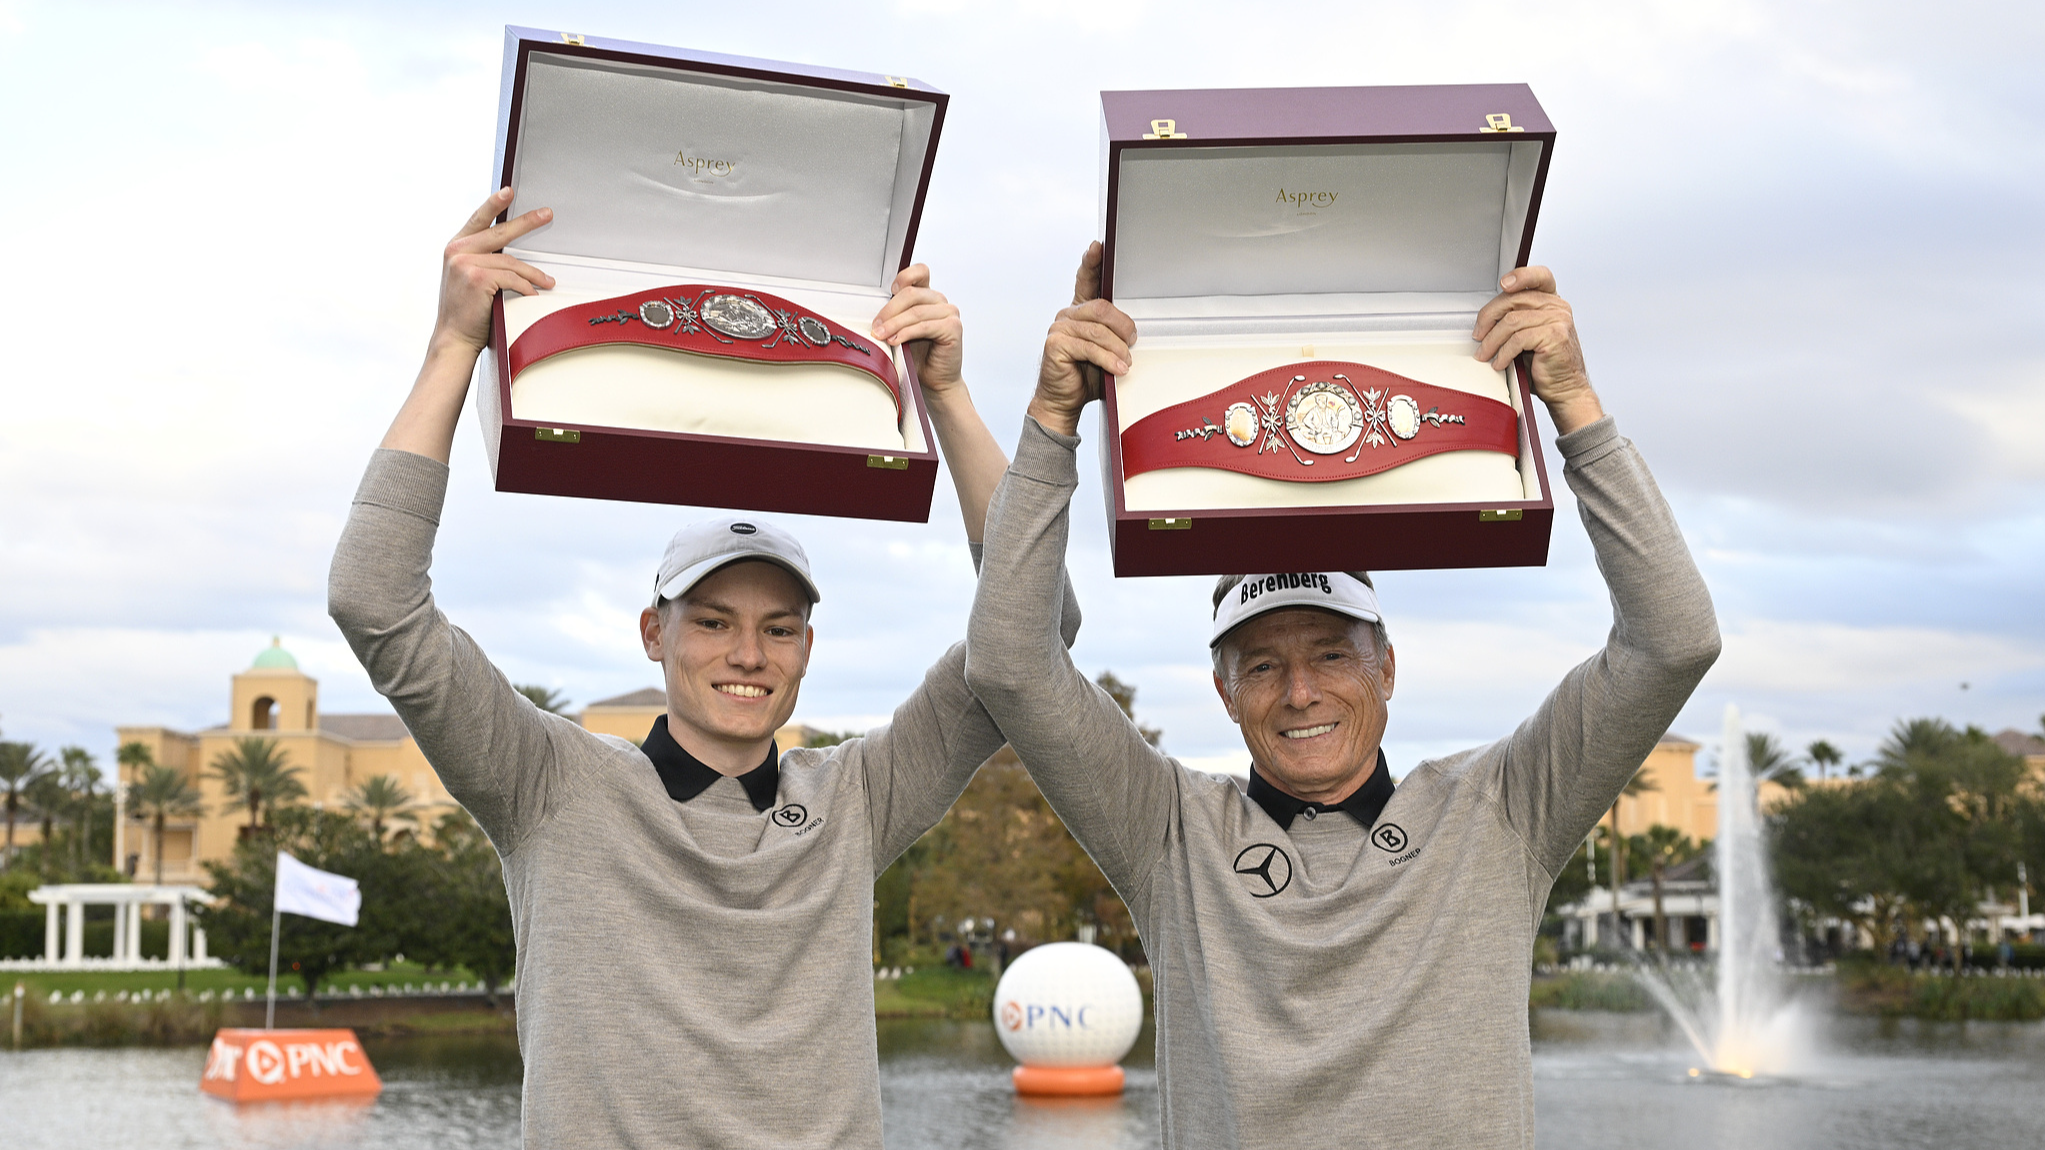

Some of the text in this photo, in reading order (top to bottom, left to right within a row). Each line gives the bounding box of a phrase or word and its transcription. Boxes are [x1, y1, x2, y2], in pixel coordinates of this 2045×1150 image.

[674, 150, 736, 177] Asprey
[1275, 187, 1339, 208] Asprey
[1241, 573, 1332, 605] Berenberg
[1027, 1004, 1096, 1029] PNC
[284, 1041, 363, 1079] PNC
